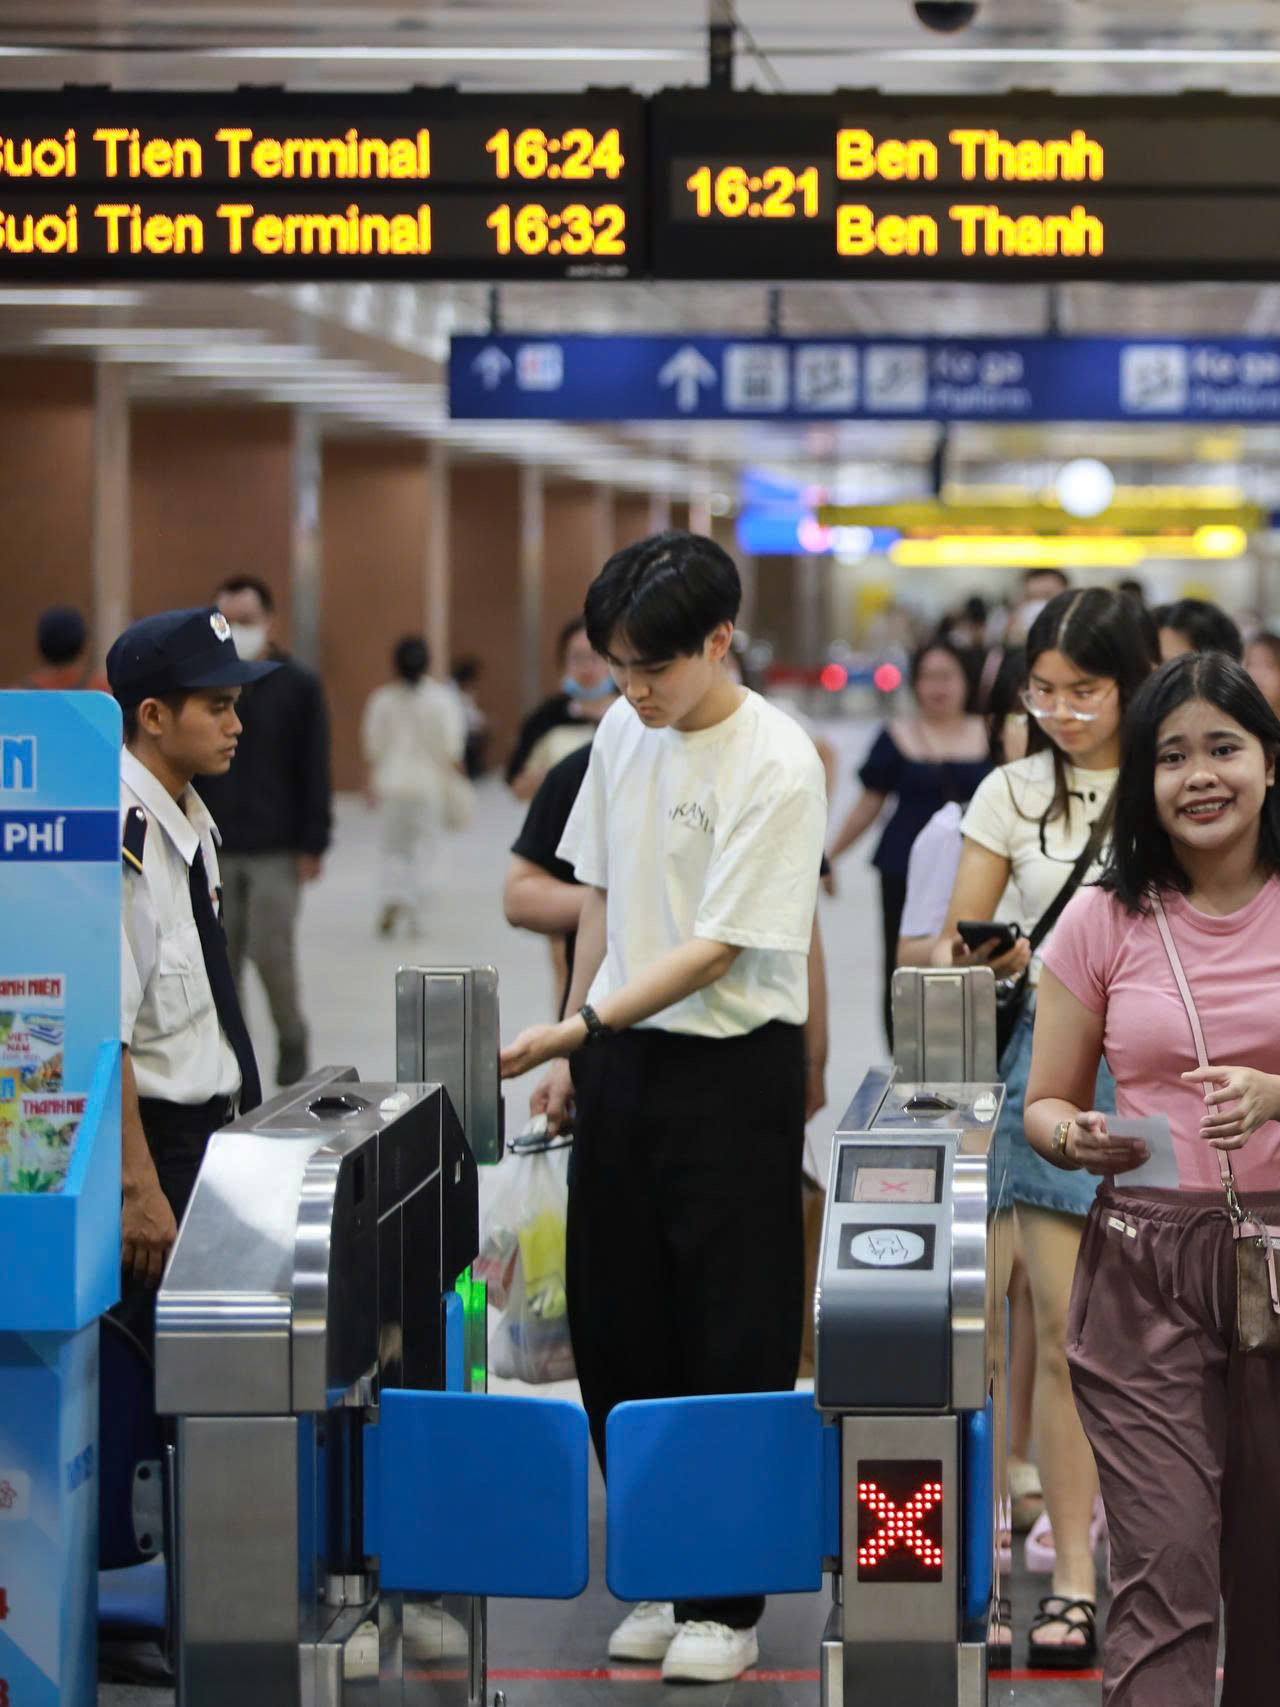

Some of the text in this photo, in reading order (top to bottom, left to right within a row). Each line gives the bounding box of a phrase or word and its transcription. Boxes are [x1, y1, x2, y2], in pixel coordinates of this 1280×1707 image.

[0, 128, 624, 179] uoi Tien Terminal 16:24
[836, 129, 938, 180] Ben
[948, 129, 1103, 180] Thanh
[687, 167, 819, 218] 16:21
[0, 204, 626, 256] uoi Tien Terminal 16:32
[836, 205, 938, 256] Ben
[948, 205, 1103, 257] Thanh
[4, 815, 67, 852] PHÍ
